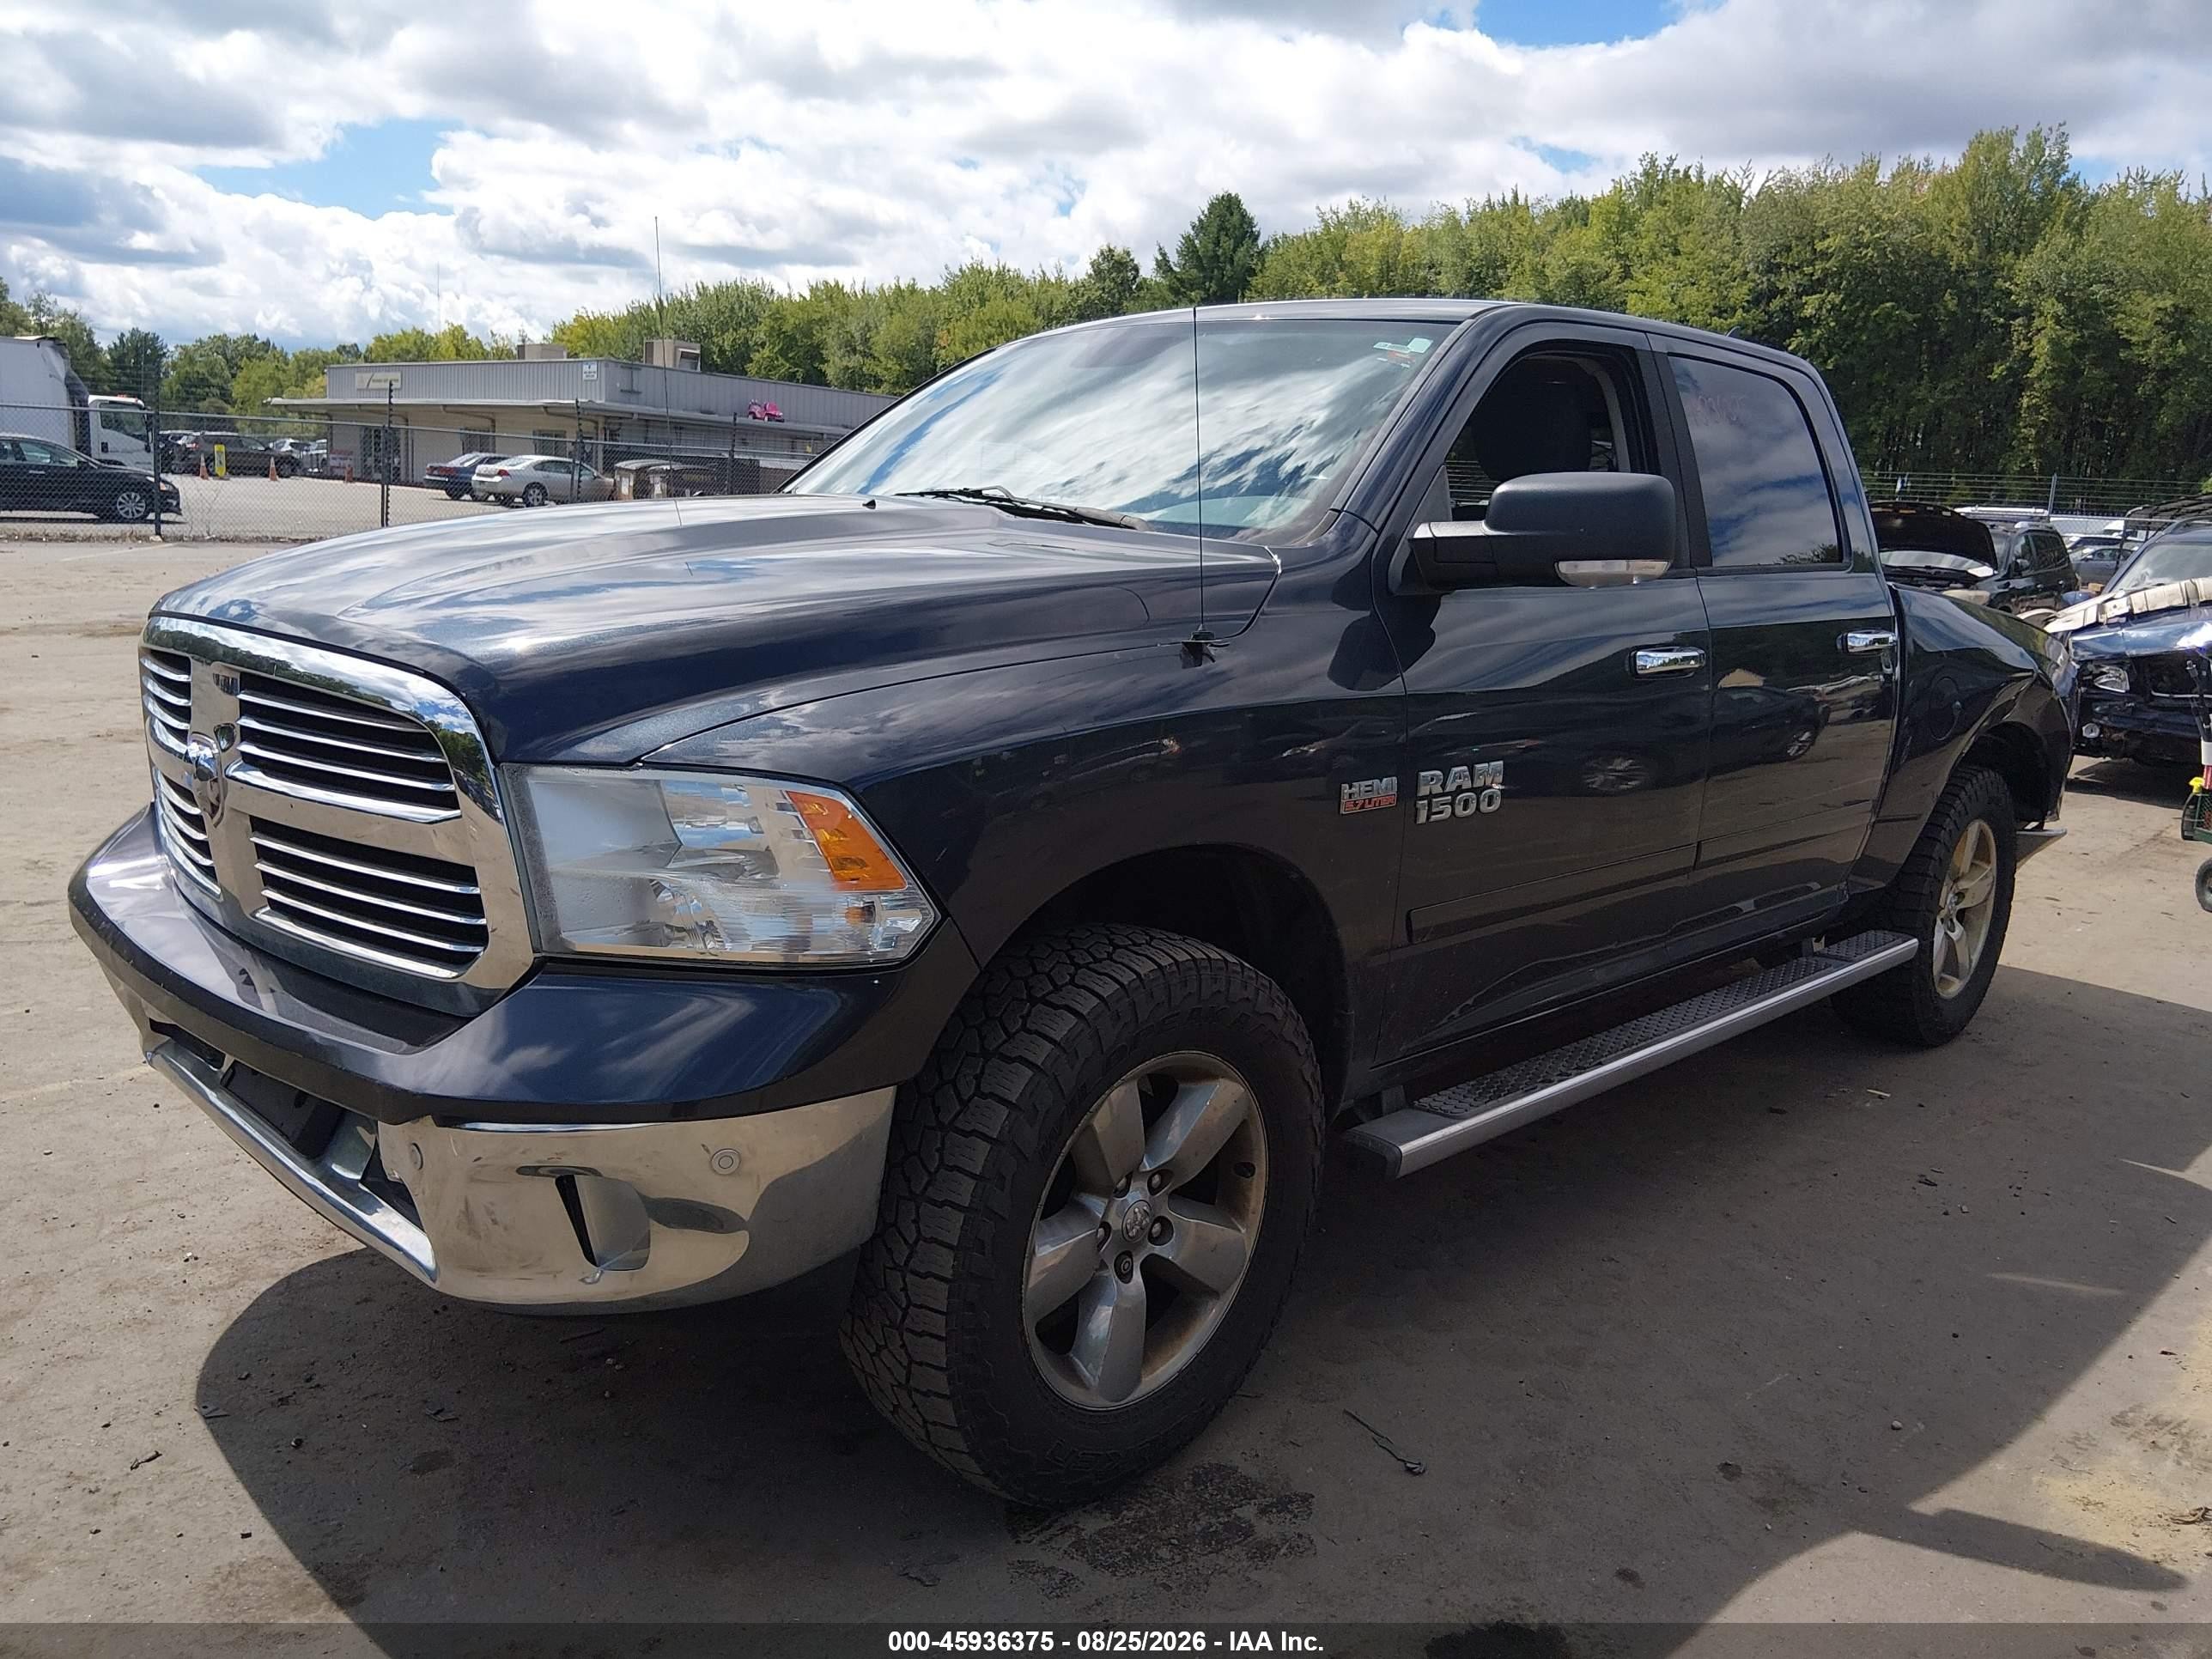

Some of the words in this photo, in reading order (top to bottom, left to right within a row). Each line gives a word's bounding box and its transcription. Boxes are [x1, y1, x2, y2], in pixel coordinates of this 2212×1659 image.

[1340, 776, 1398, 800] HEMI
[1418, 760, 1504, 795] RAM
[1364, 795, 1395, 809] LITER
[1415, 788, 1502, 824] 1500
